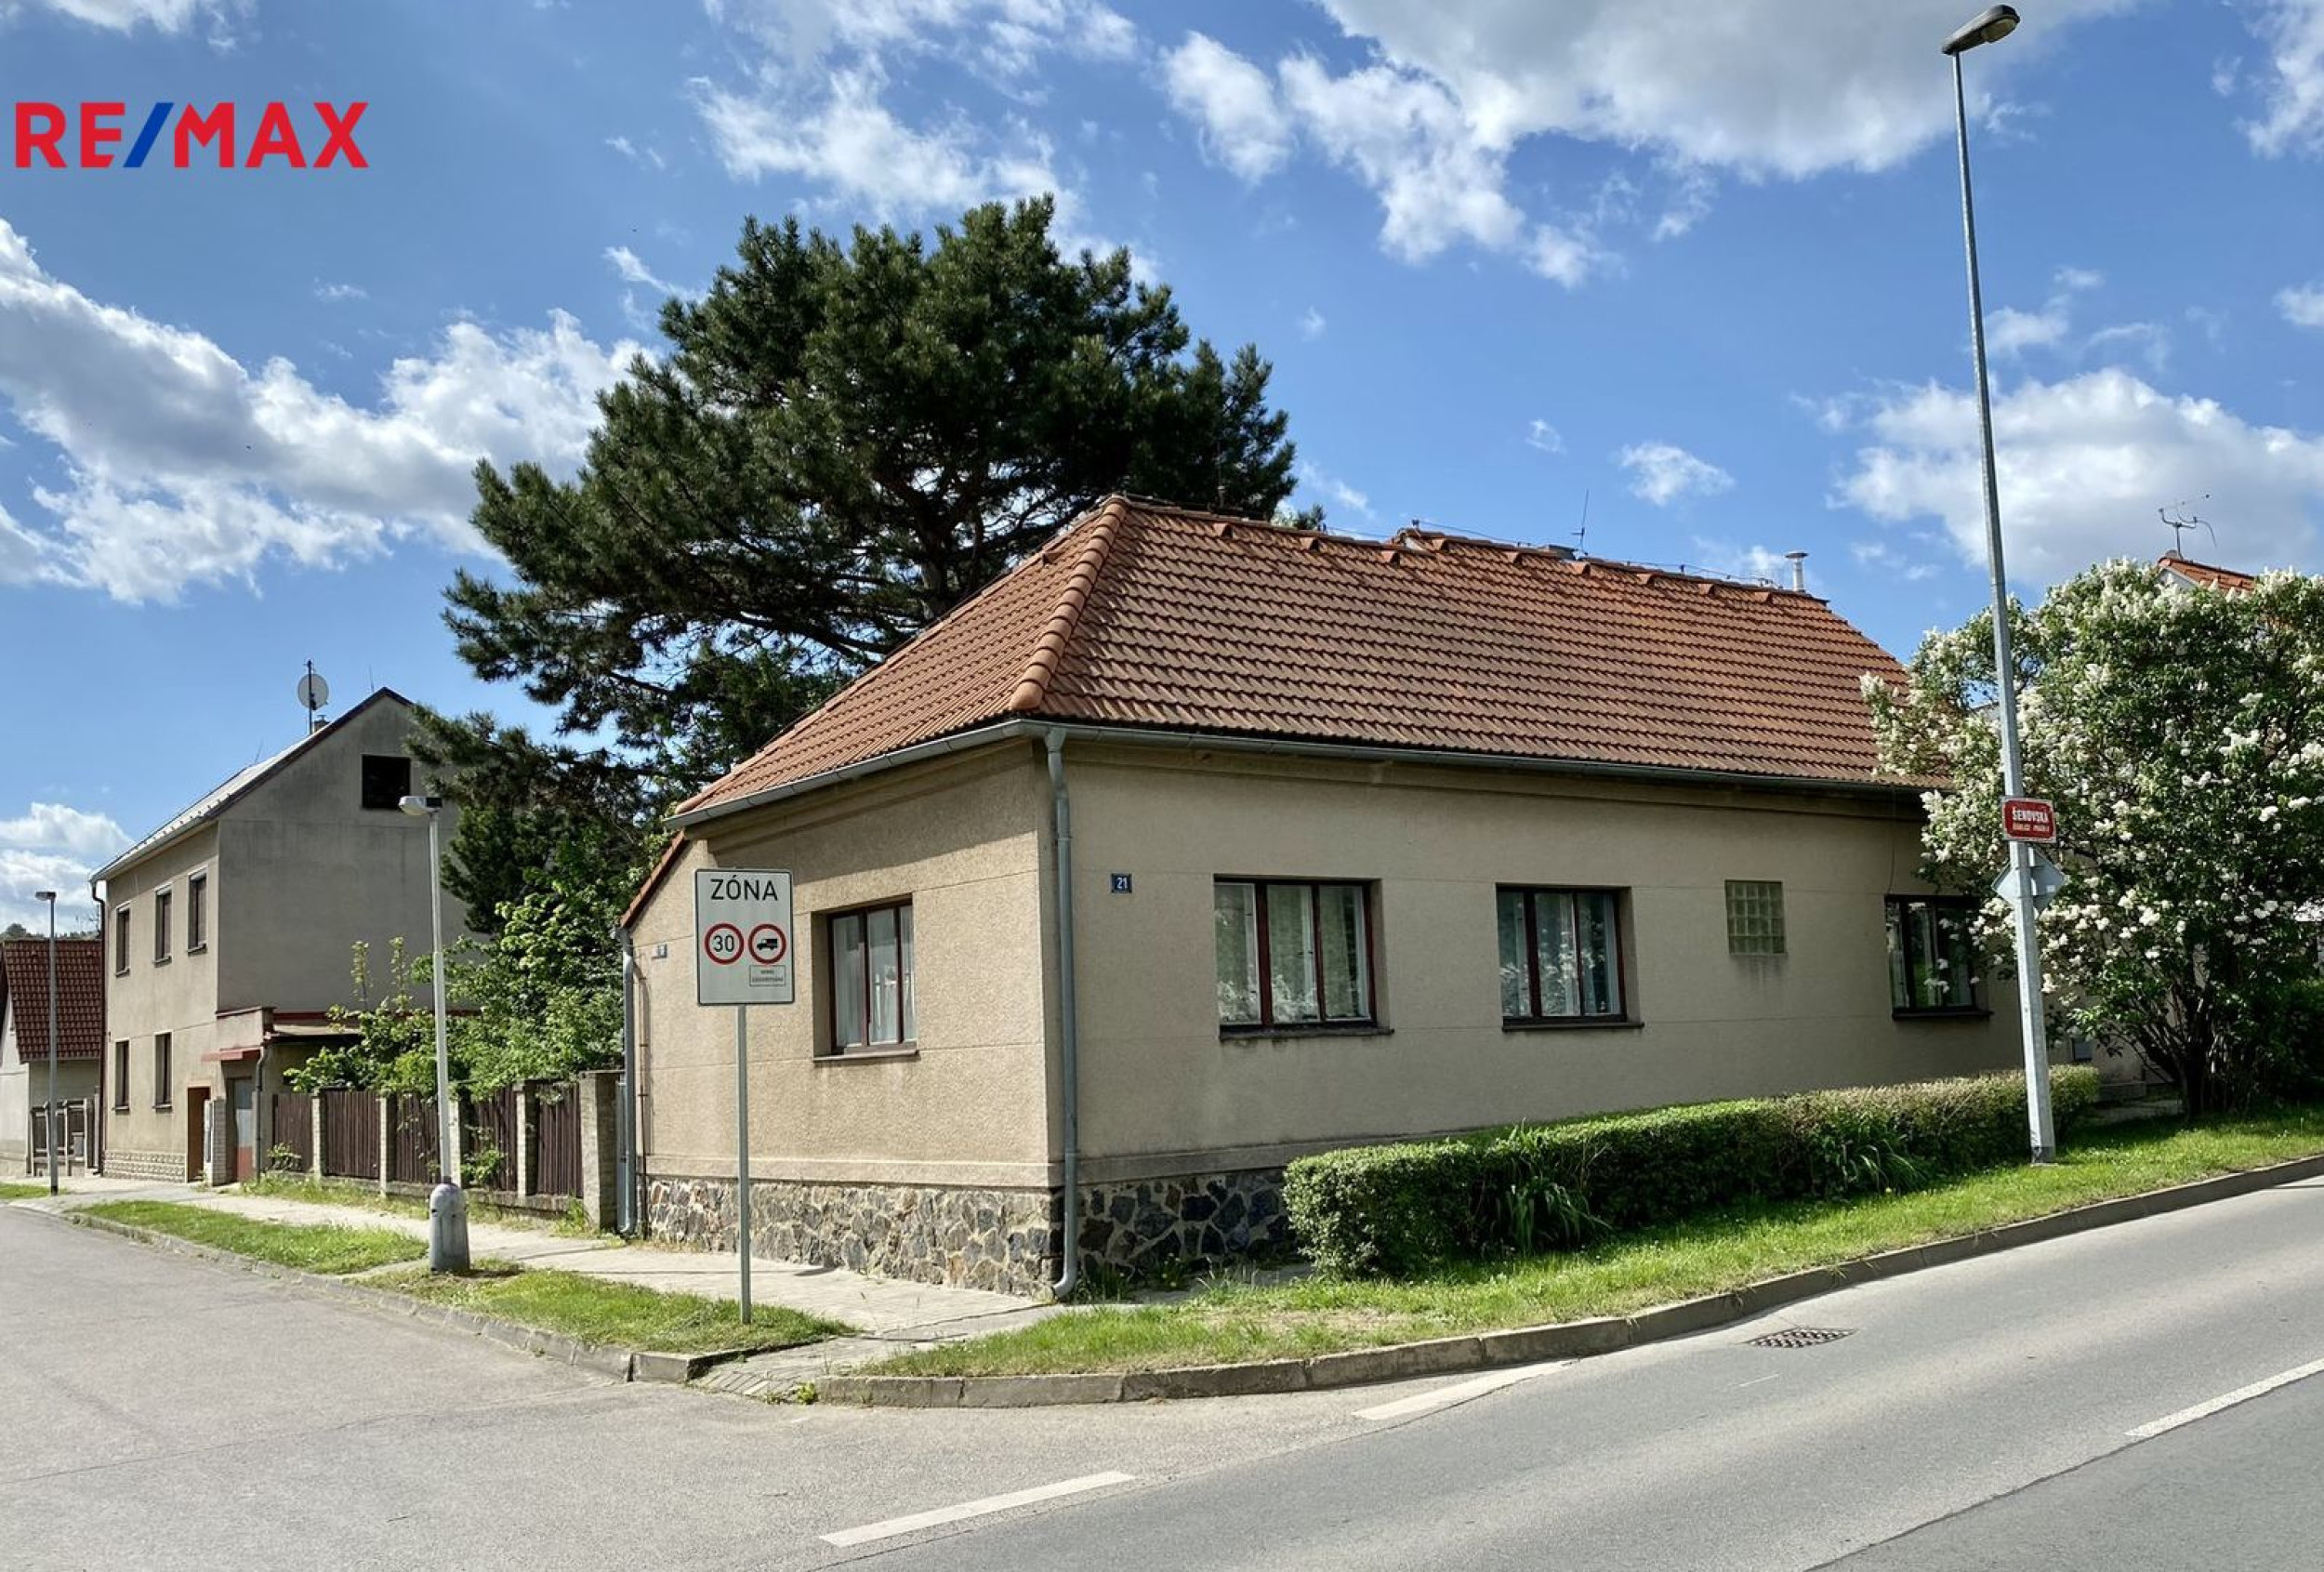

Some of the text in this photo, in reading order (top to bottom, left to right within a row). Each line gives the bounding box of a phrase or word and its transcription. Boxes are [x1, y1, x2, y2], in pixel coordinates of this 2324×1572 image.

[710, 874, 778, 901] ZÓNA
[1116, 877, 1129, 889] 21
[713, 934, 734, 953] 30
